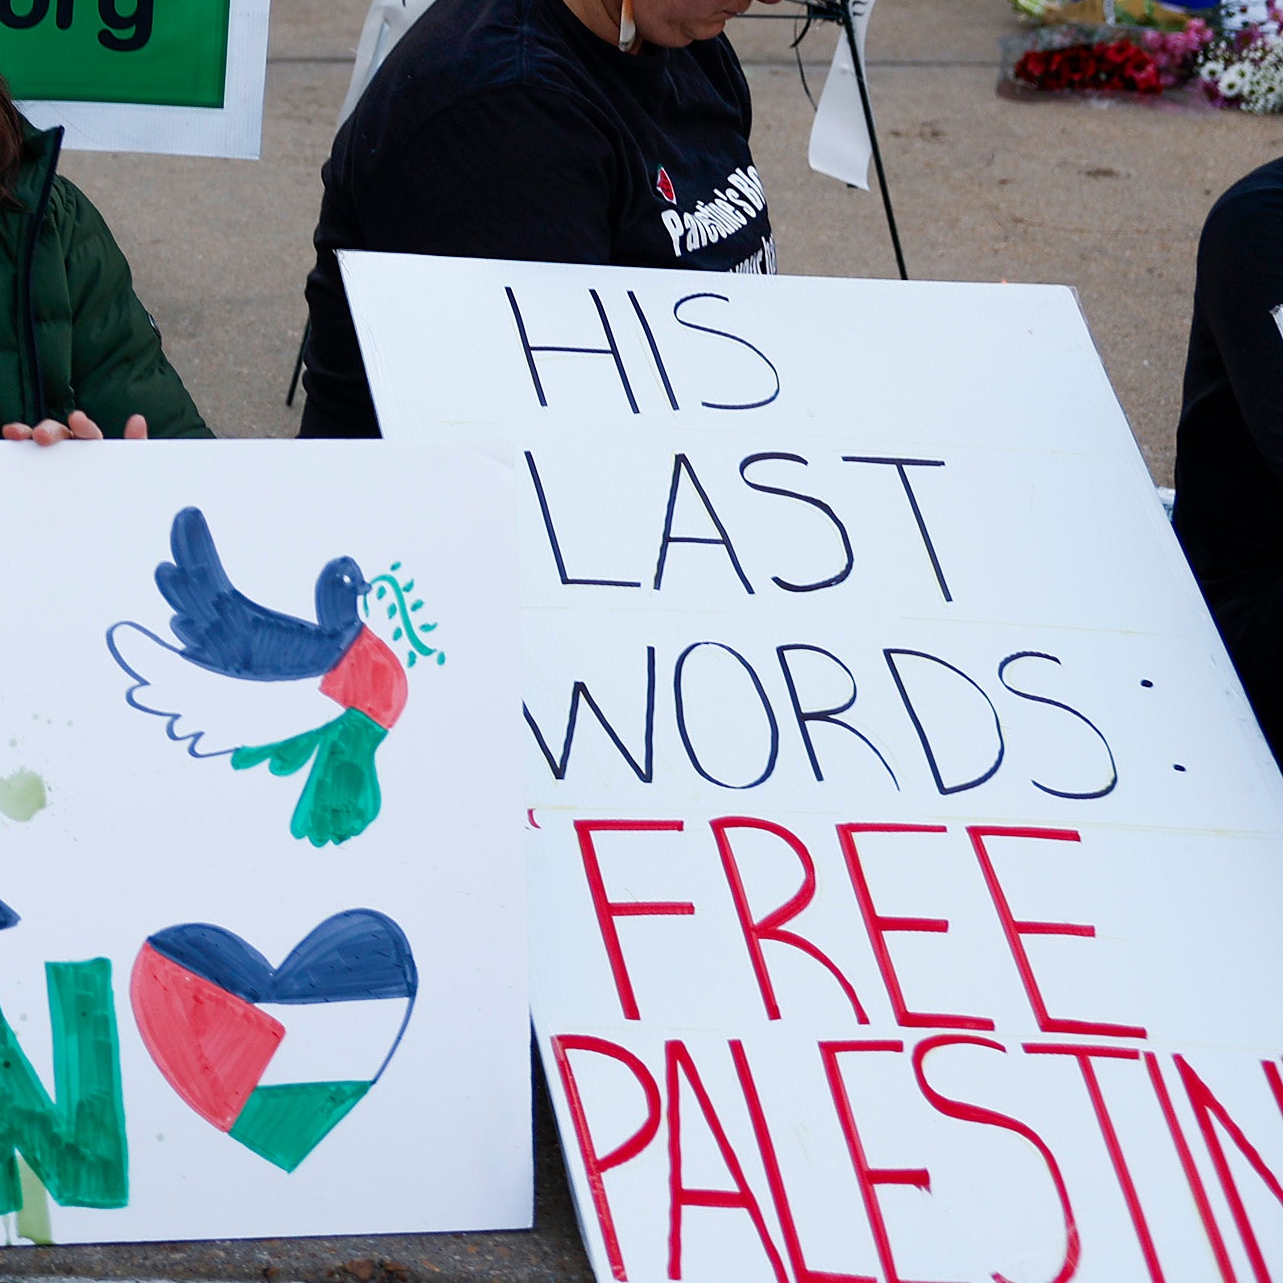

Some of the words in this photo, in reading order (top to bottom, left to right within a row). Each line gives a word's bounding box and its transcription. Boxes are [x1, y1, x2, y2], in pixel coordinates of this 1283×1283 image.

[504, 285, 780, 415] HIS
[523, 449, 953, 603] LAST
[551, 1034, 1283, 1283] PALESTIN
